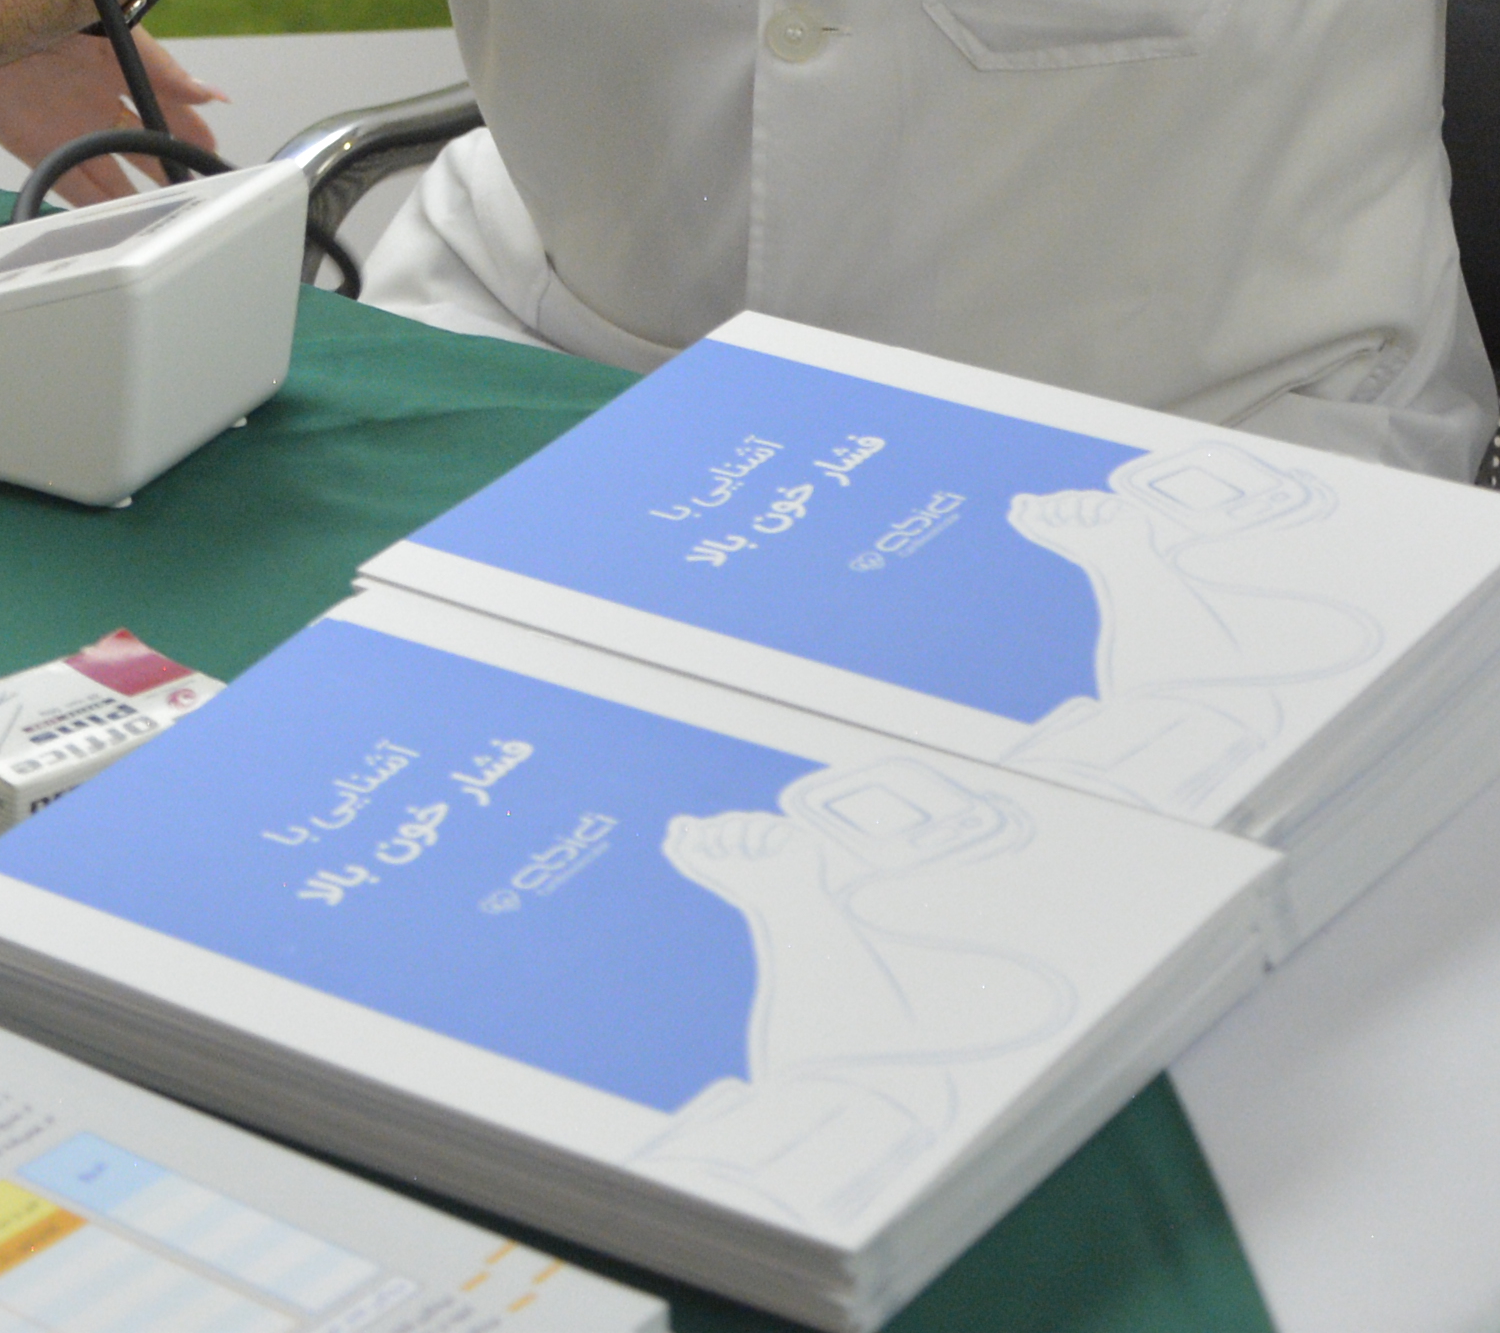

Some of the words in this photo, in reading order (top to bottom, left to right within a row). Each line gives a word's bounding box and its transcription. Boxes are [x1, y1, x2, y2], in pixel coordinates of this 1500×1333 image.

[691, 433, 785, 508] آشنایی
[812, 434, 887, 488] فشار
[649, 503, 703, 522] با
[752, 483, 815, 535] خون
[684, 534, 760, 569] بالا
[8, 715, 159, 776] Office
[28, 702, 140, 744] Pins
[309, 737, 422, 830] آشنایی
[450, 737, 536, 808] فشار
[261, 824, 322, 848] با
[374, 801, 450, 866] خون
[296, 864, 381, 907] بالا
